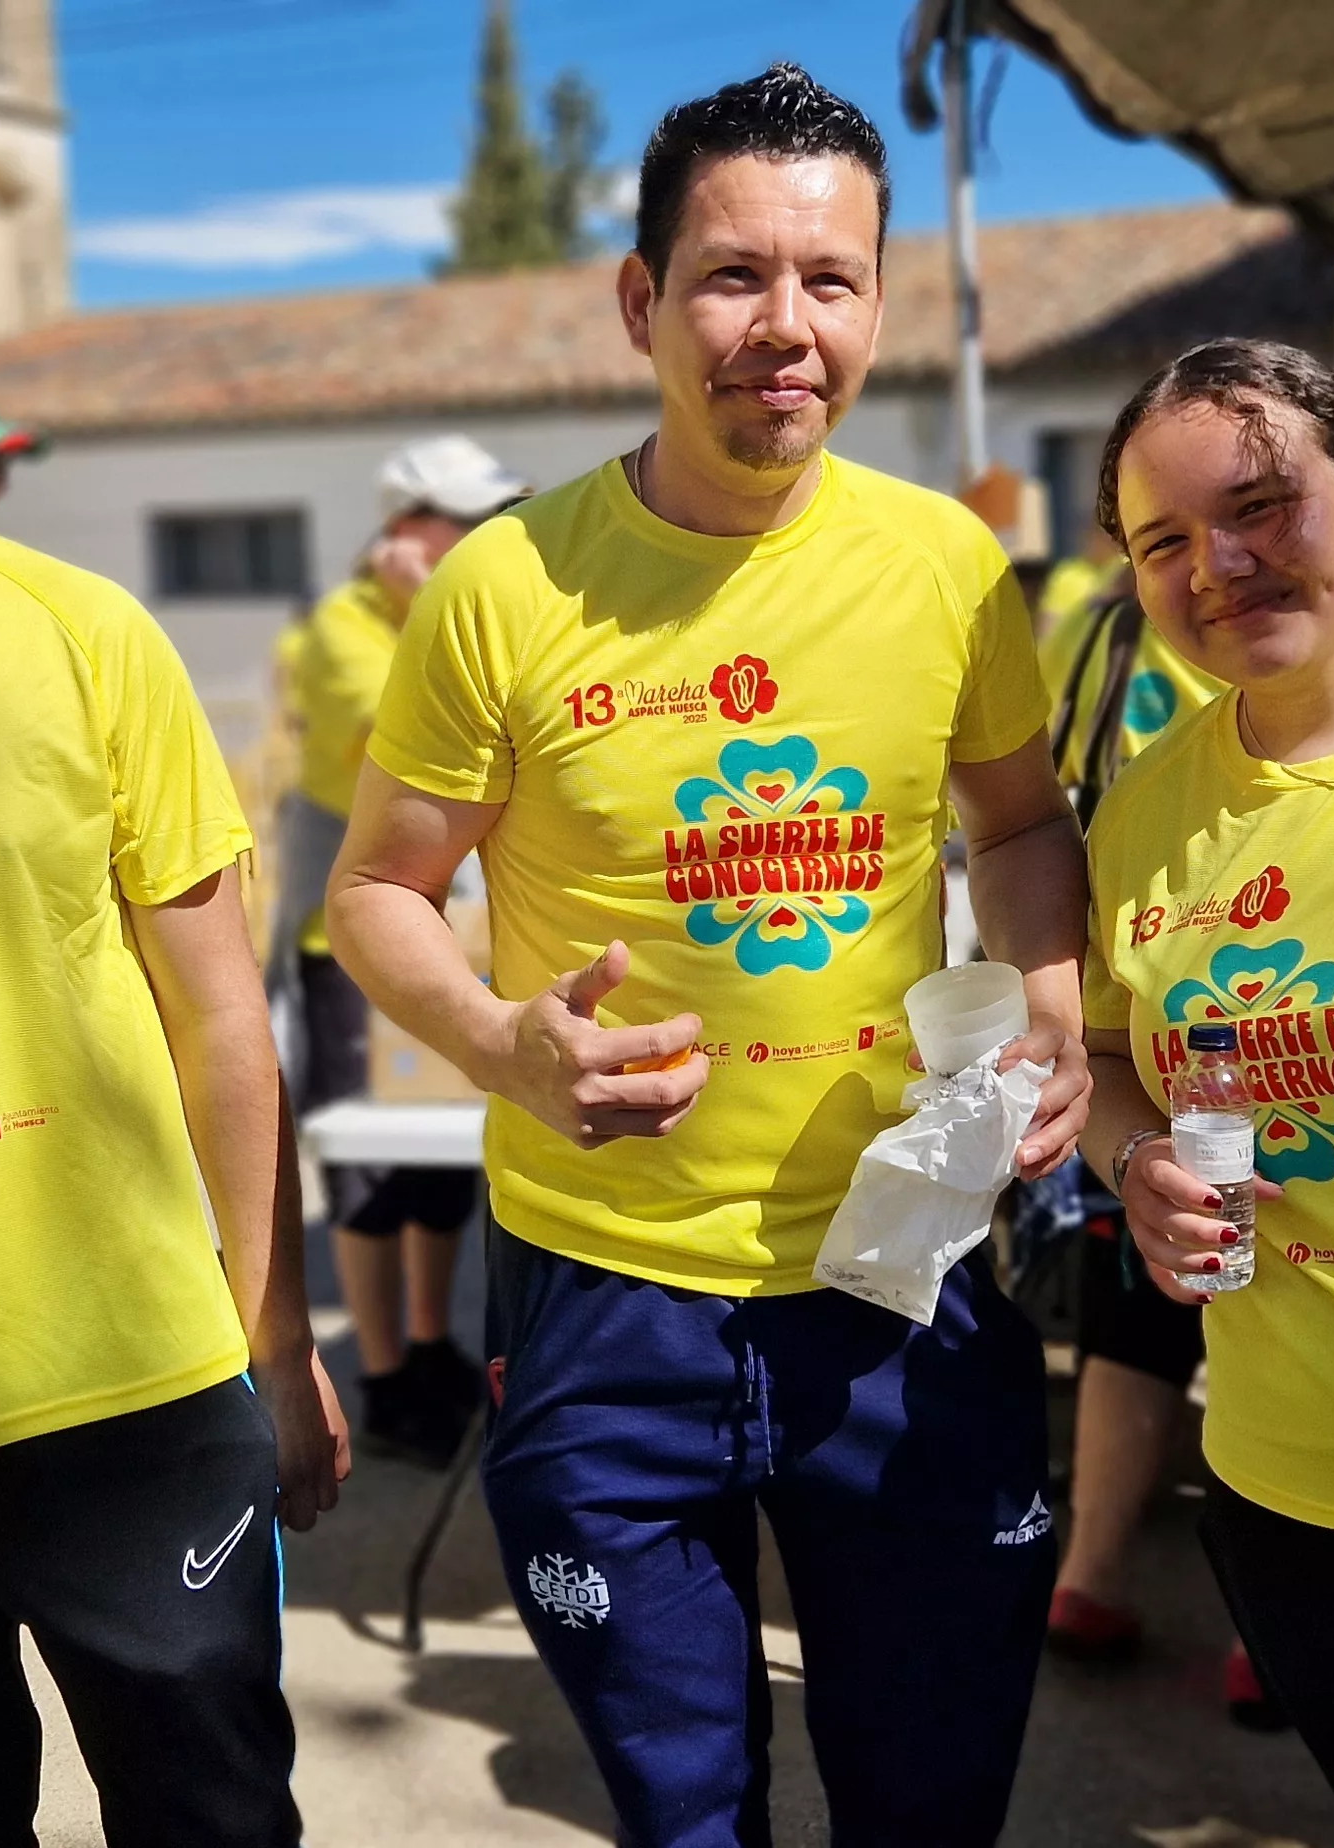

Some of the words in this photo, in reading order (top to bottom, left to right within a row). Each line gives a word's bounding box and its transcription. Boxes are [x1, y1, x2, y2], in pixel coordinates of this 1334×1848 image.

[625, 677, 707, 705] Marcha
[628, 704, 665, 718] ASPACE
[668, 701, 708, 714] HUESCA
[683, 714, 707, 724] 2025
[664, 826, 707, 864] LA
[718, 816, 838, 857] SUERTE
[848, 813, 885, 851] DE
[665, 853, 885, 904] CONOCERNOS
[772, 1045, 801, 1057] hoya
[803, 1043, 816, 1053] de
[817, 1038, 850, 1051] huesca
[1152, 1028, 1187, 1074] LA
[12, 1117, 46, 1130] Huesca
[535, 1577, 601, 1604] CETDI
